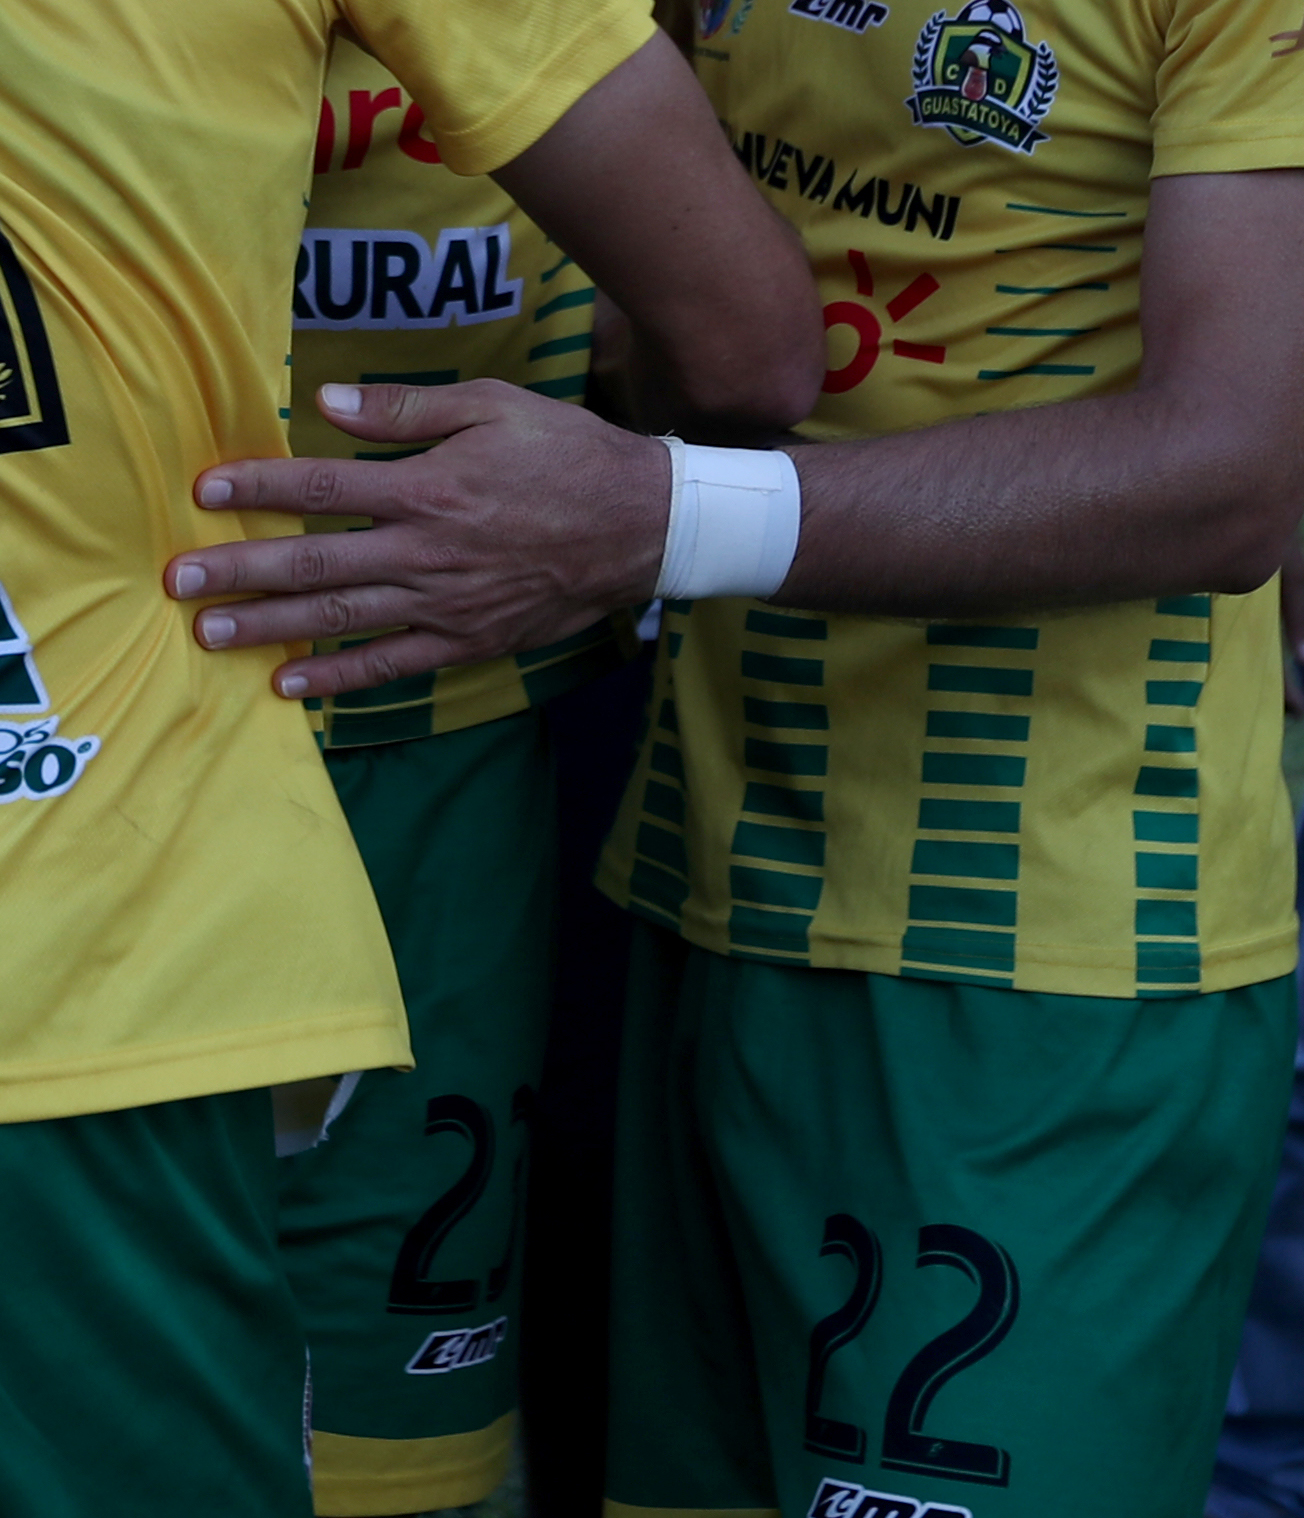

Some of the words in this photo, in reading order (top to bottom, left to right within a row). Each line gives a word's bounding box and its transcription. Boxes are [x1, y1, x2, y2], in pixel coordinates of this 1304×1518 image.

[946, 63, 961, 80] C
[994, 78, 1008, 95] D
[921, 95, 1022, 142] GUASTATOYA
[833, 169, 961, 241] MUNI
[804, 1213, 1021, 1487] 22
